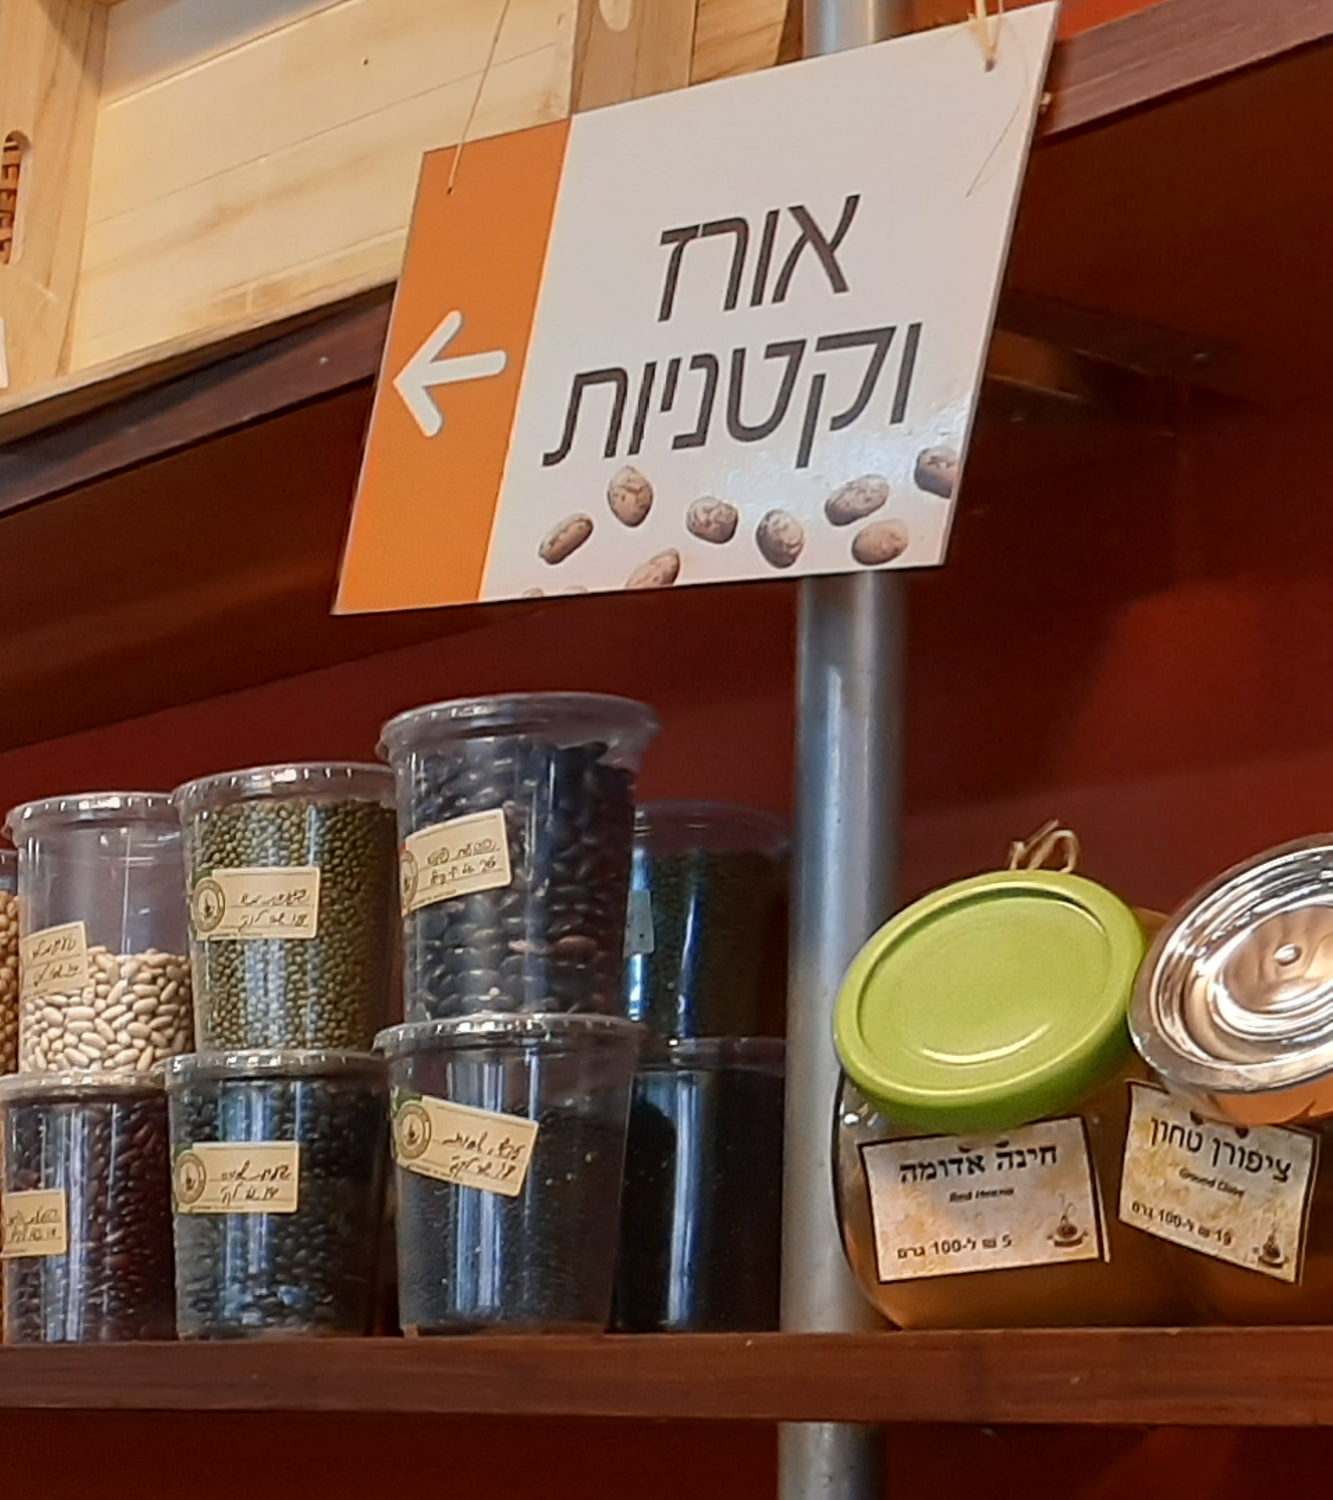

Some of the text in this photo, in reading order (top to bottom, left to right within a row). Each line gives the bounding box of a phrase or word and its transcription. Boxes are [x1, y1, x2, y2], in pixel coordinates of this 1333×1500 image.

[658, 194, 861, 323] אורז
[541, 322, 923, 470] וקטניות
[899, 1145, 1058, 1184] חינה אדומה
[1150, 1117, 1292, 1183] ציפורן טחון
[896, 1245, 926, 1260] גרם
[1002, 1233, 1013, 1248] 5
